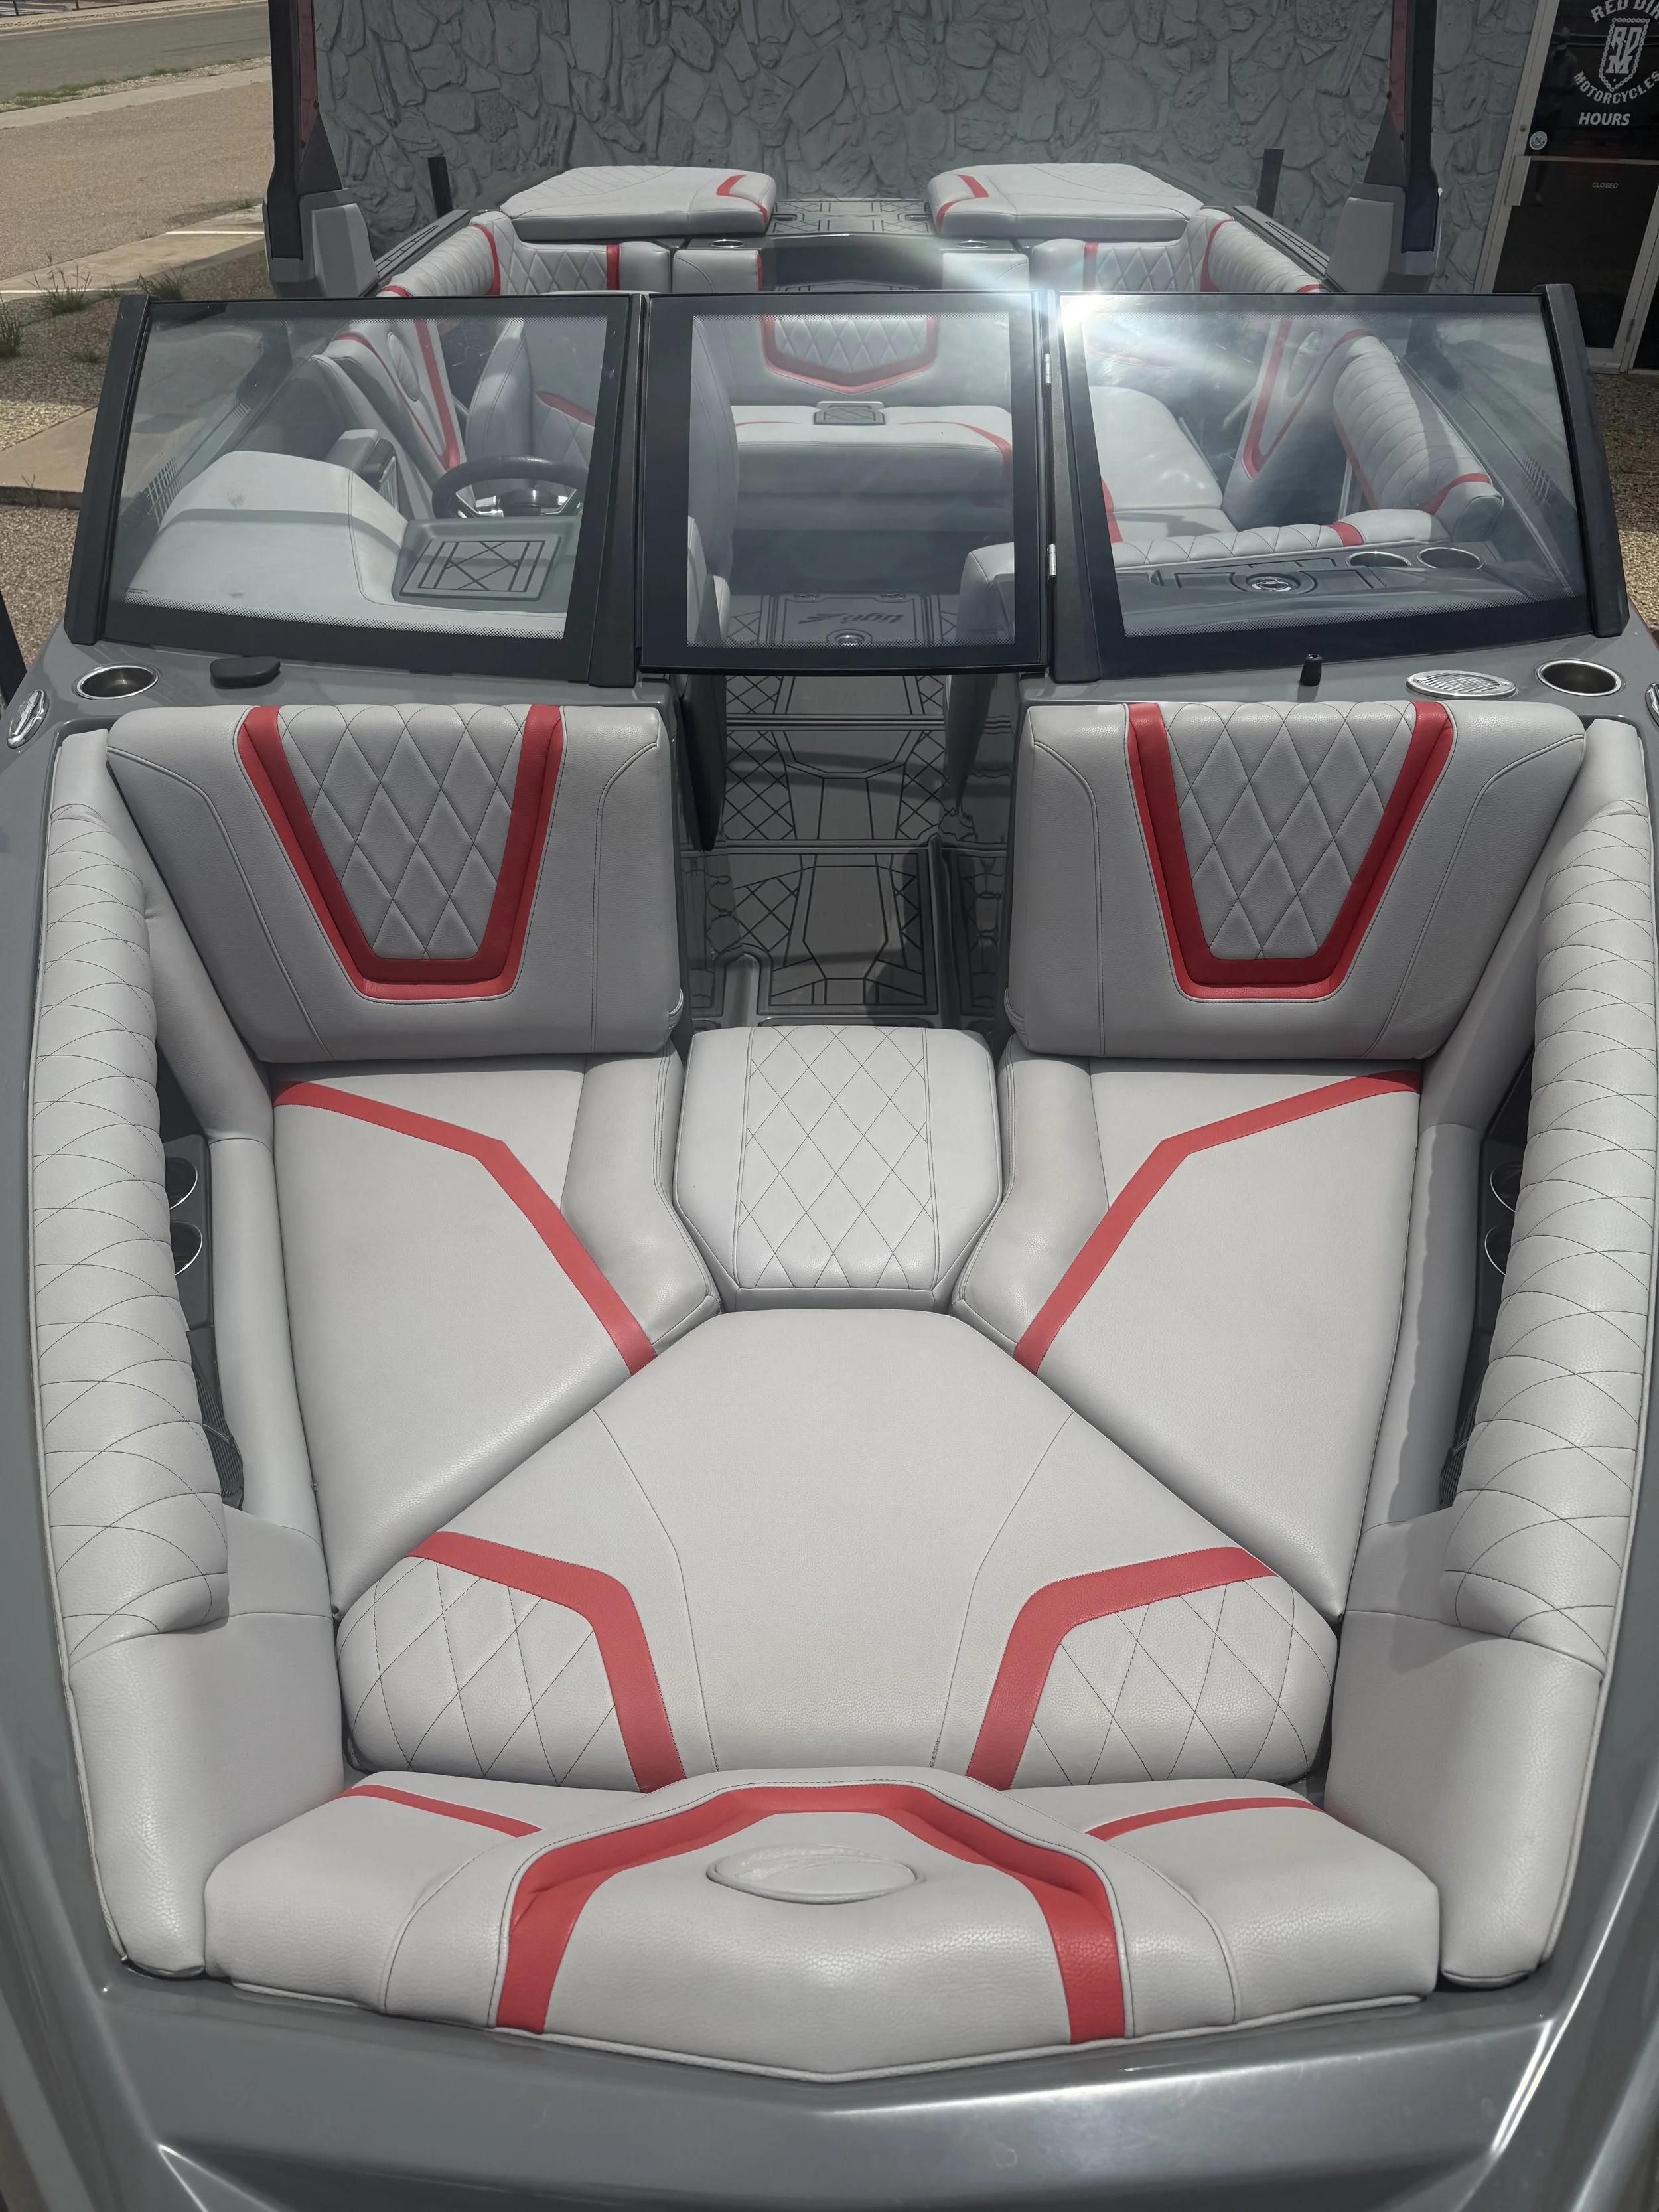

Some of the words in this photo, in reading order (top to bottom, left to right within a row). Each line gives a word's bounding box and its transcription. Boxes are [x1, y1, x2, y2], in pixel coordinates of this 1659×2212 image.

[1591, 0, 1628, 23] RED
[1573, 70, 1659, 104] MOTORCYCLES
[1578, 111, 1631, 127] HOURS
